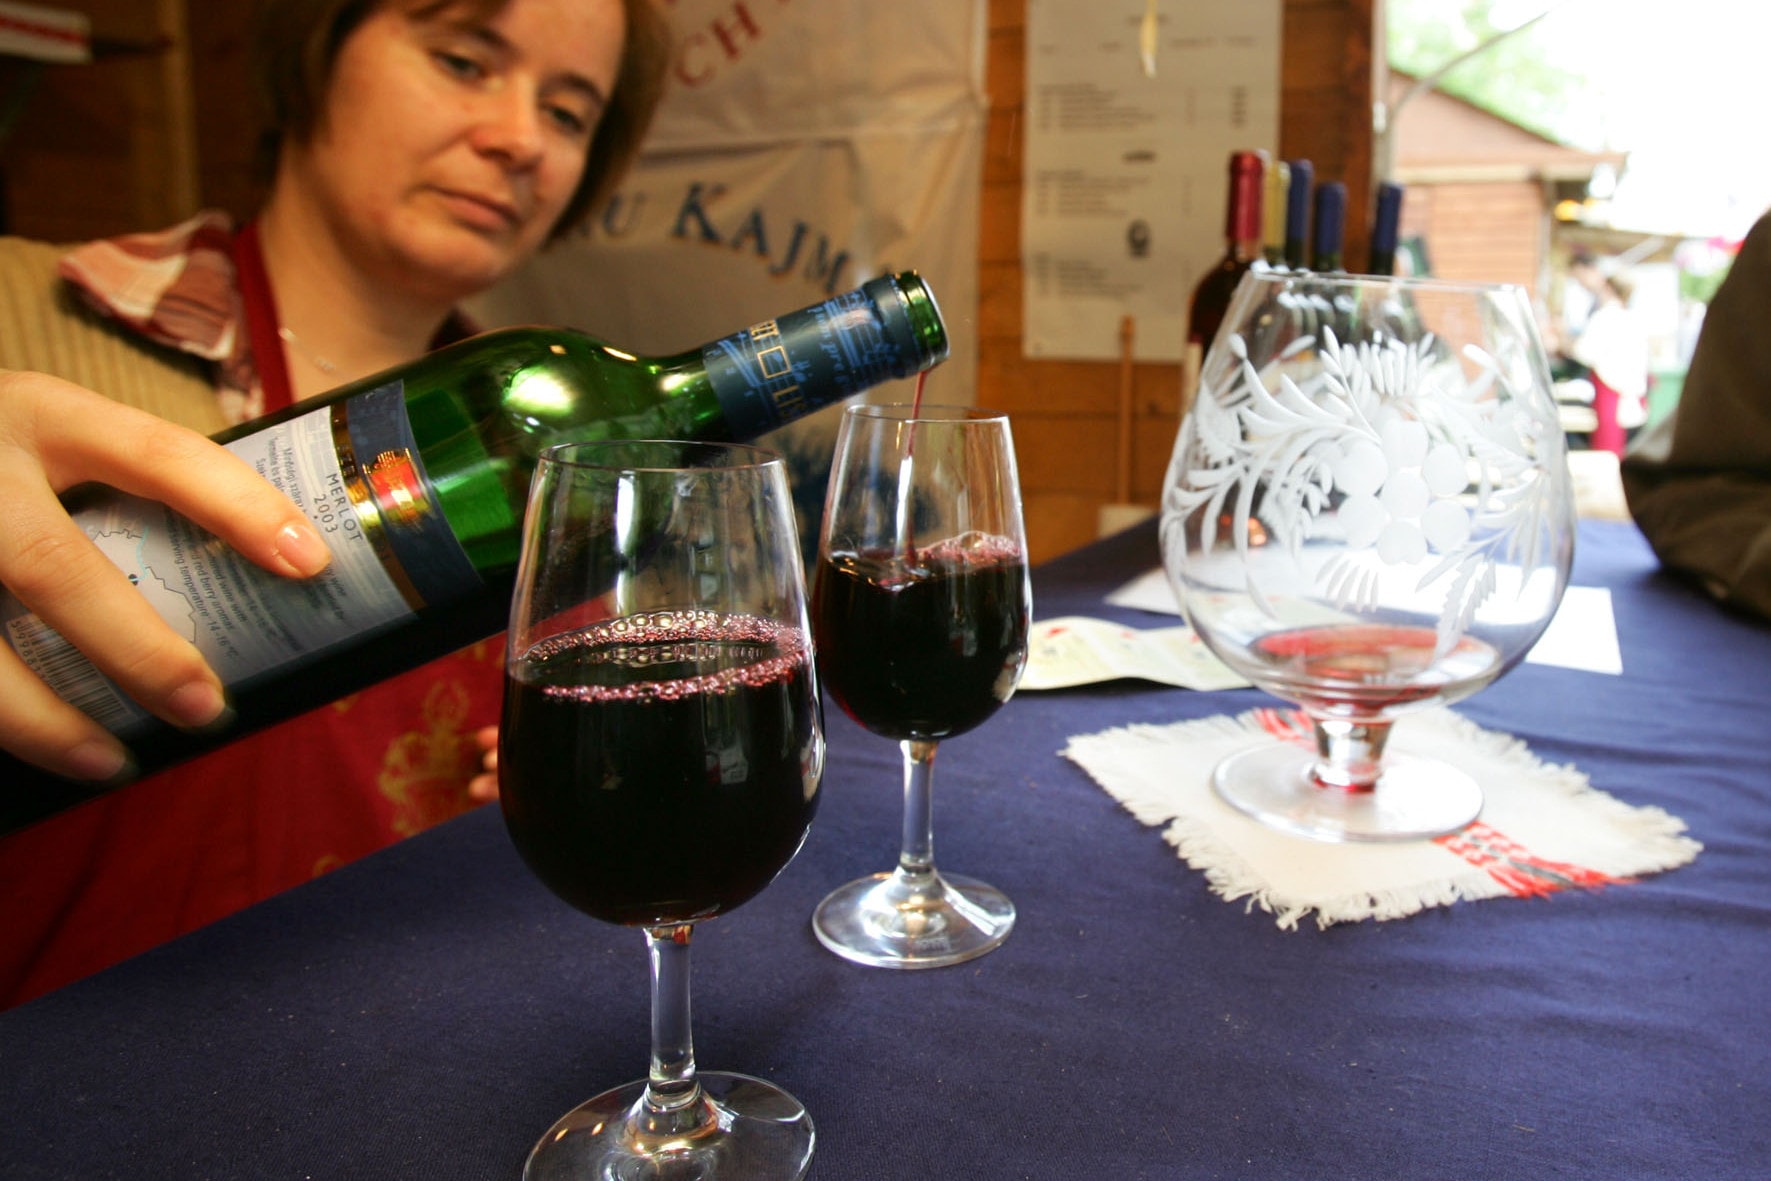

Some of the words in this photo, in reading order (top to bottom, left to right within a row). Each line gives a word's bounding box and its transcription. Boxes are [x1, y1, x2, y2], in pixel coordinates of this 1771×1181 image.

[673, 1, 764, 88] CH
[672, 182, 850, 295] KAJM
[313, 493, 339, 534] 2003
[325, 472, 363, 541] MERLOT
[200, 576, 217, 601] berry
